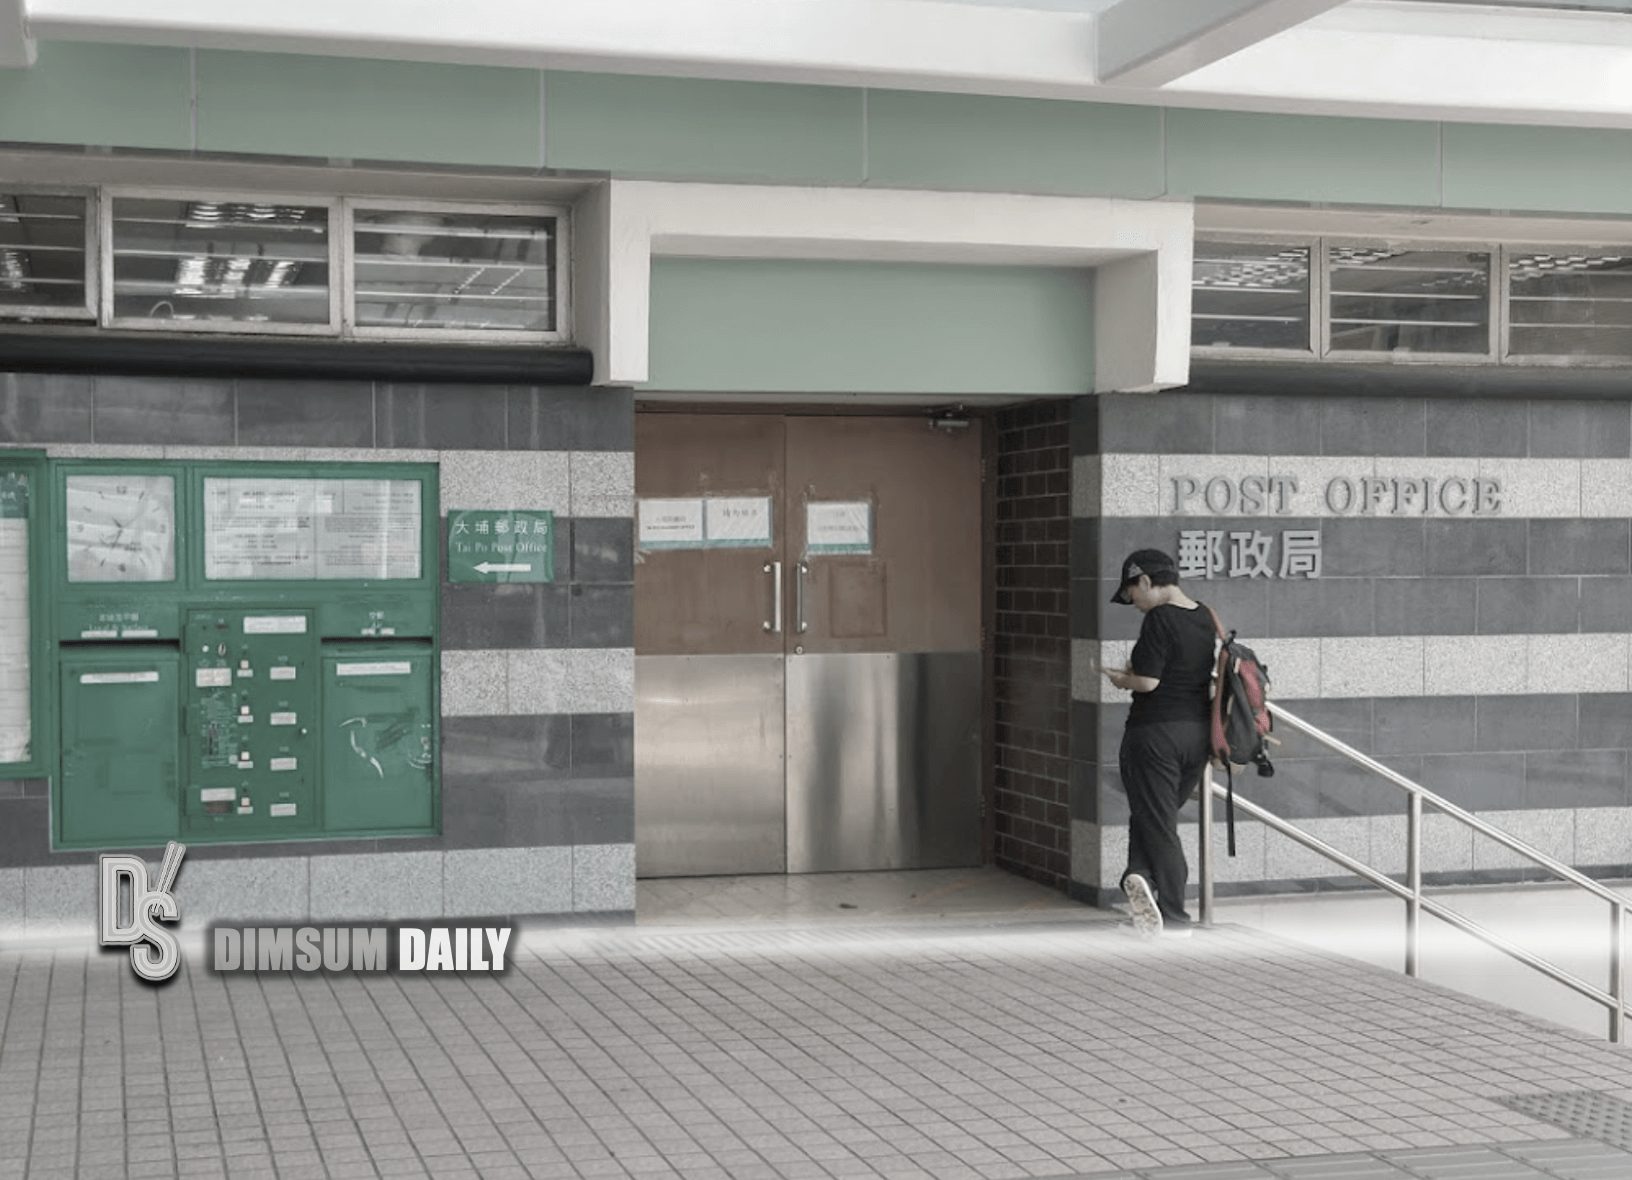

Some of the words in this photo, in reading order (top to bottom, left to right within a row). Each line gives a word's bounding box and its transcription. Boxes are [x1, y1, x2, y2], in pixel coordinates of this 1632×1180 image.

[1170, 476, 1297, 515] POST
[1324, 476, 1500, 515] OFFICE
[455, 519, 547, 535] 大埔郵政局
[455, 542, 471, 553] Tai
[475, 542, 488, 553] Po
[491, 542, 513, 553] Post
[516, 541, 547, 553] Office
[1178, 529, 1322, 581] 郵政局
